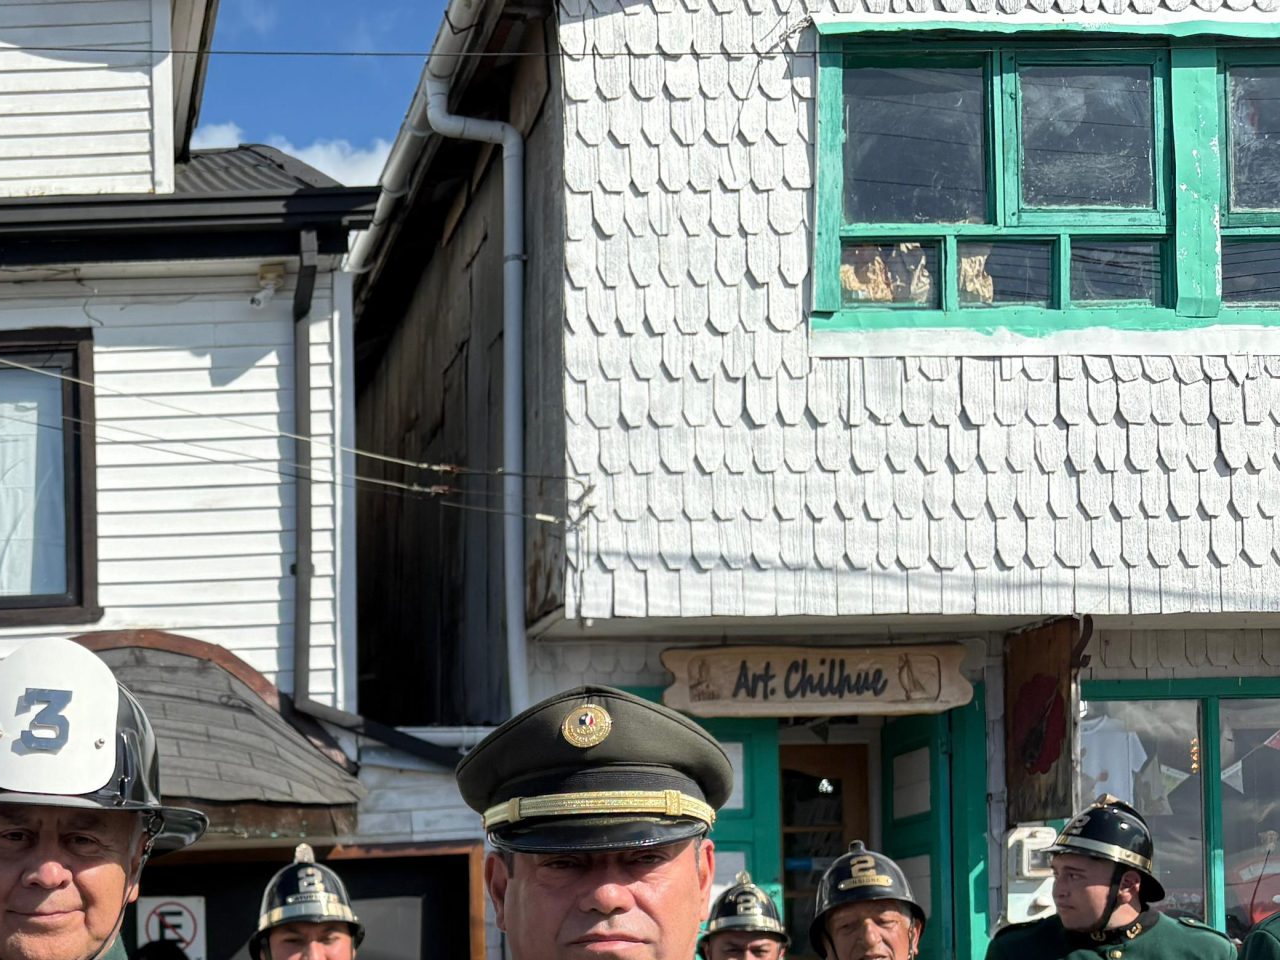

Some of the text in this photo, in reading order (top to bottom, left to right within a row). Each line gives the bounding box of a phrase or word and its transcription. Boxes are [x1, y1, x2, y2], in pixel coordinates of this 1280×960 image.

[732, 658, 888, 700] Art. Chilhue
[20, 688, 72, 751] 3
[850, 855, 876, 878] 2
